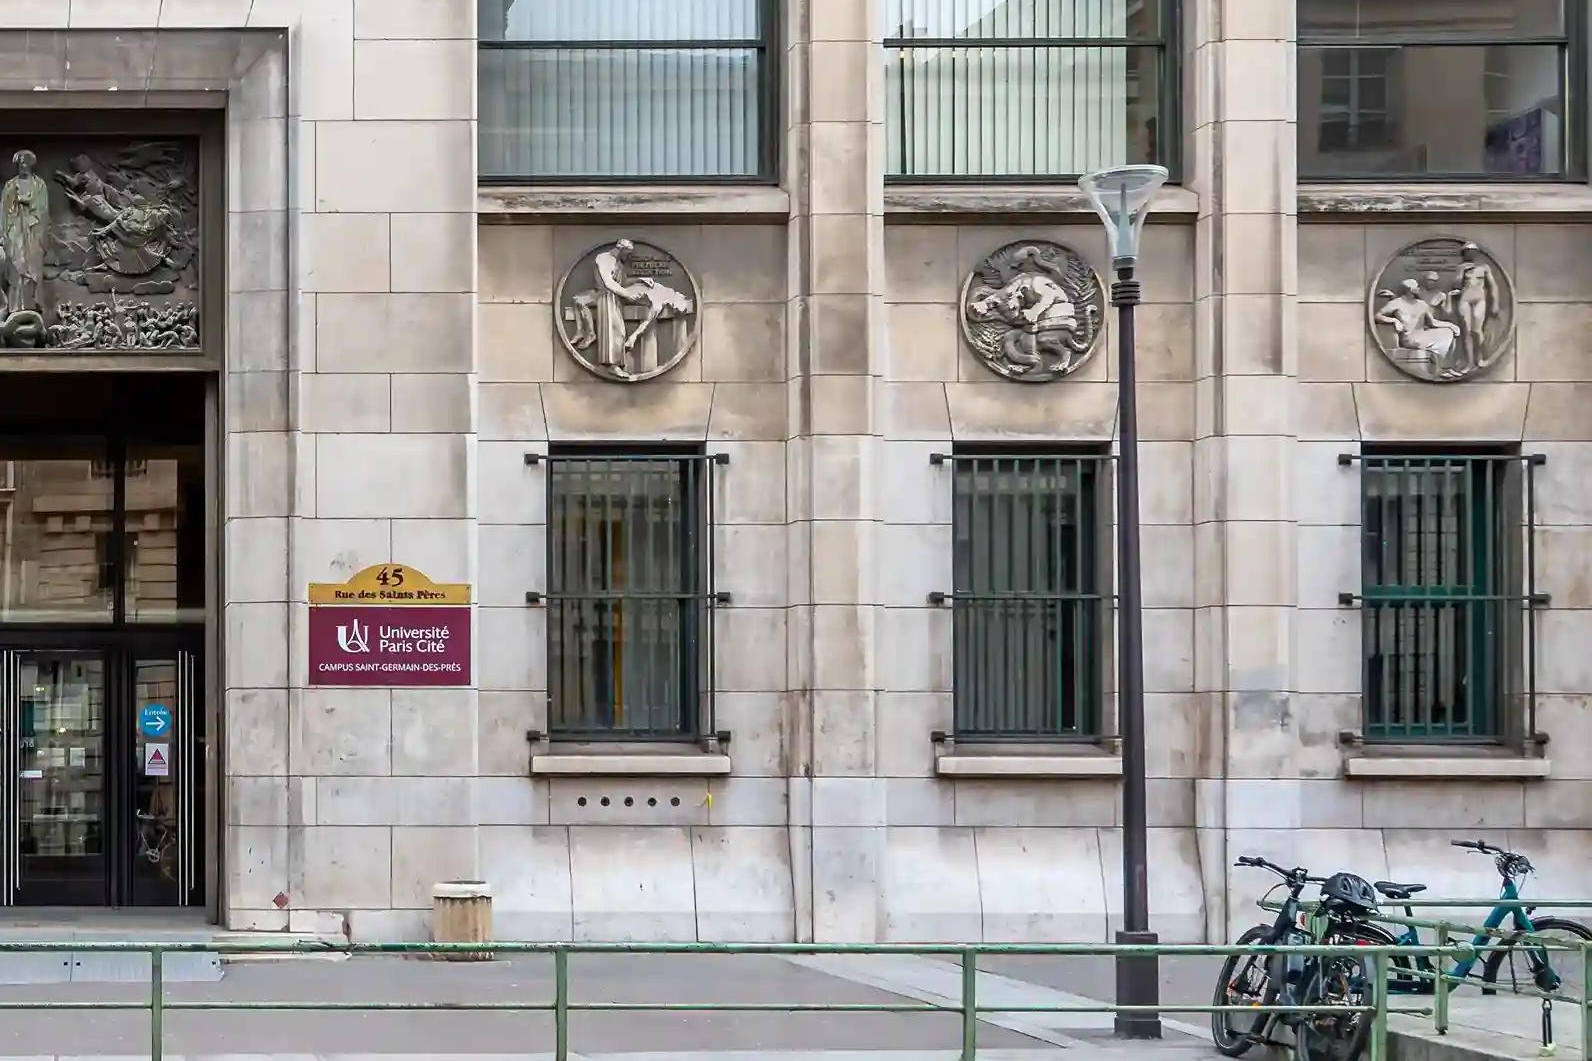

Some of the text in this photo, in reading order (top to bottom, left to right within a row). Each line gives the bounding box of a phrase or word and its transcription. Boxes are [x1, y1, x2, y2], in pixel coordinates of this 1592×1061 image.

[375, 567, 404, 587] 45
[334, 589, 446, 600] Rue des Saints Pères
[379, 625, 450, 640] Université
[379, 639, 445, 654] Paris Cité
[318, 662, 461, 672] CAMPUS SAINT-GERMAIN-DES-PRÉS
